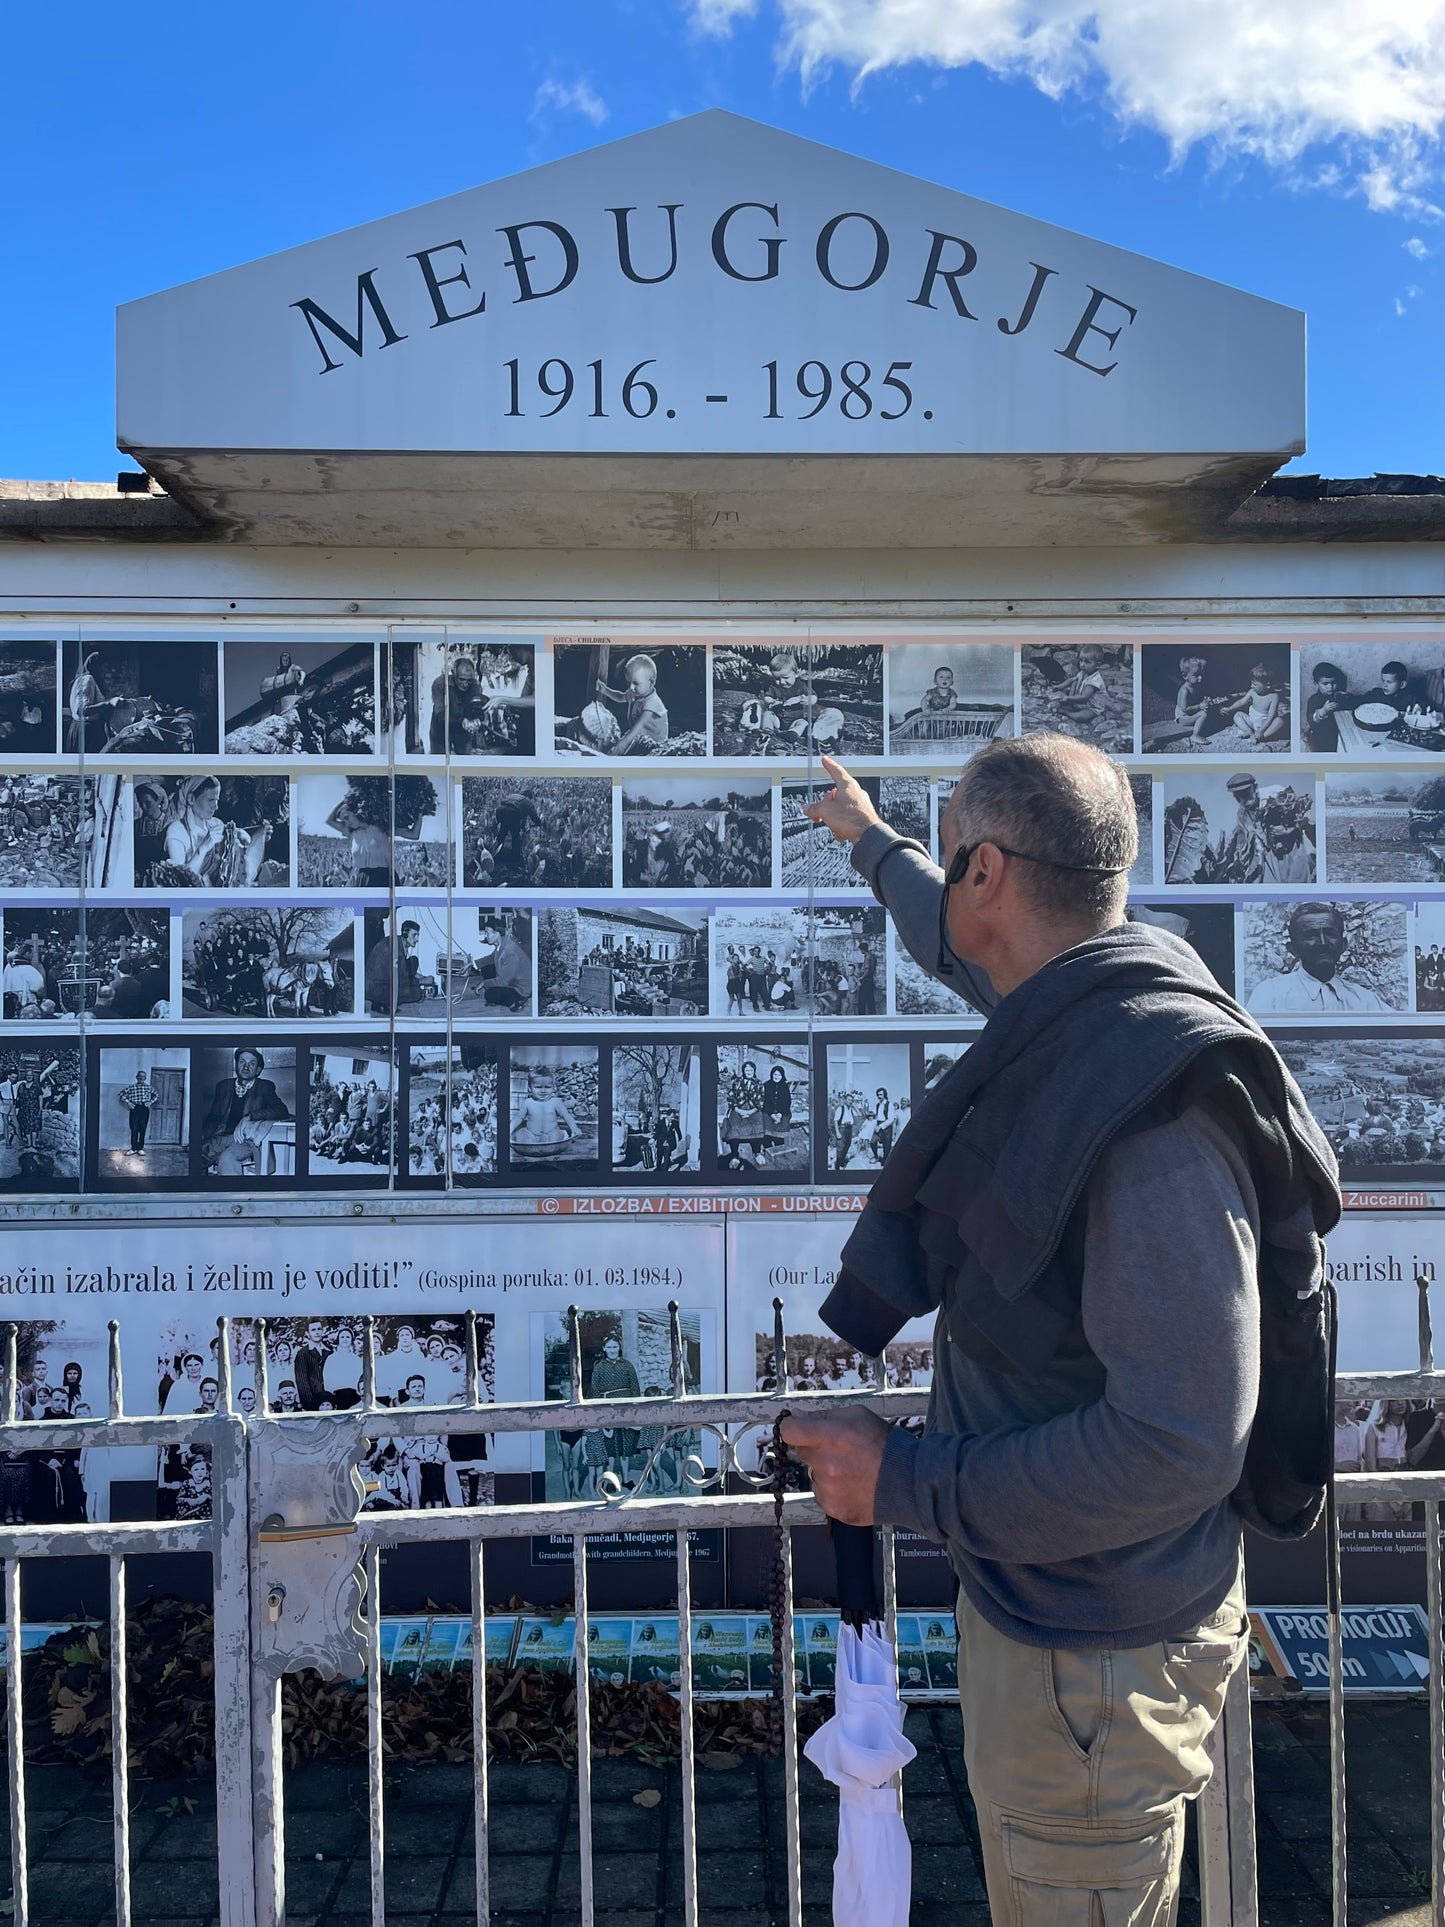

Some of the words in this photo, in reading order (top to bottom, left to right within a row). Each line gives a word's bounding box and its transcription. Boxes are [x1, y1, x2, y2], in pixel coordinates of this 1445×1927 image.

[289, 202, 1139, 377] MEĐUGORJE
[503, 358, 676, 420] 1916.
[705, 394, 728, 403] -
[761, 360, 934, 421] 1985.
[573, 1197, 654, 1213] IZLOŽBA
[669, 1197, 761, 1213] EXIBITION
[782, 1196, 864, 1212] UDRUGA
[1348, 1192, 1424, 1206] Zuccarini
[769, 1266, 808, 1289] (Our
[1411, 1254, 1438, 1281] in
[65, 1266, 177, 1293] izabrala
[186, 1265, 195, 1291] i
[203, 1264, 275, 1292] želim
[281, 1263, 306, 1298] je
[418, 1269, 497, 1293] (Gospina
[503, 1269, 568, 1291] poruka:
[550, 1534, 573, 1544] Baka
[624, 1530, 675, 1544] Medjugorje
[1358, 1530, 1370, 1539] na
[1371, 1529, 1393, 1539] brdu
[1395, 1529, 1427, 1539] ukazan
[900, 1548, 940, 1558] Tambourine
[1346, 1544, 1383, 1553] visionaries
[1394, 1543, 1427, 1554] Apparitio
